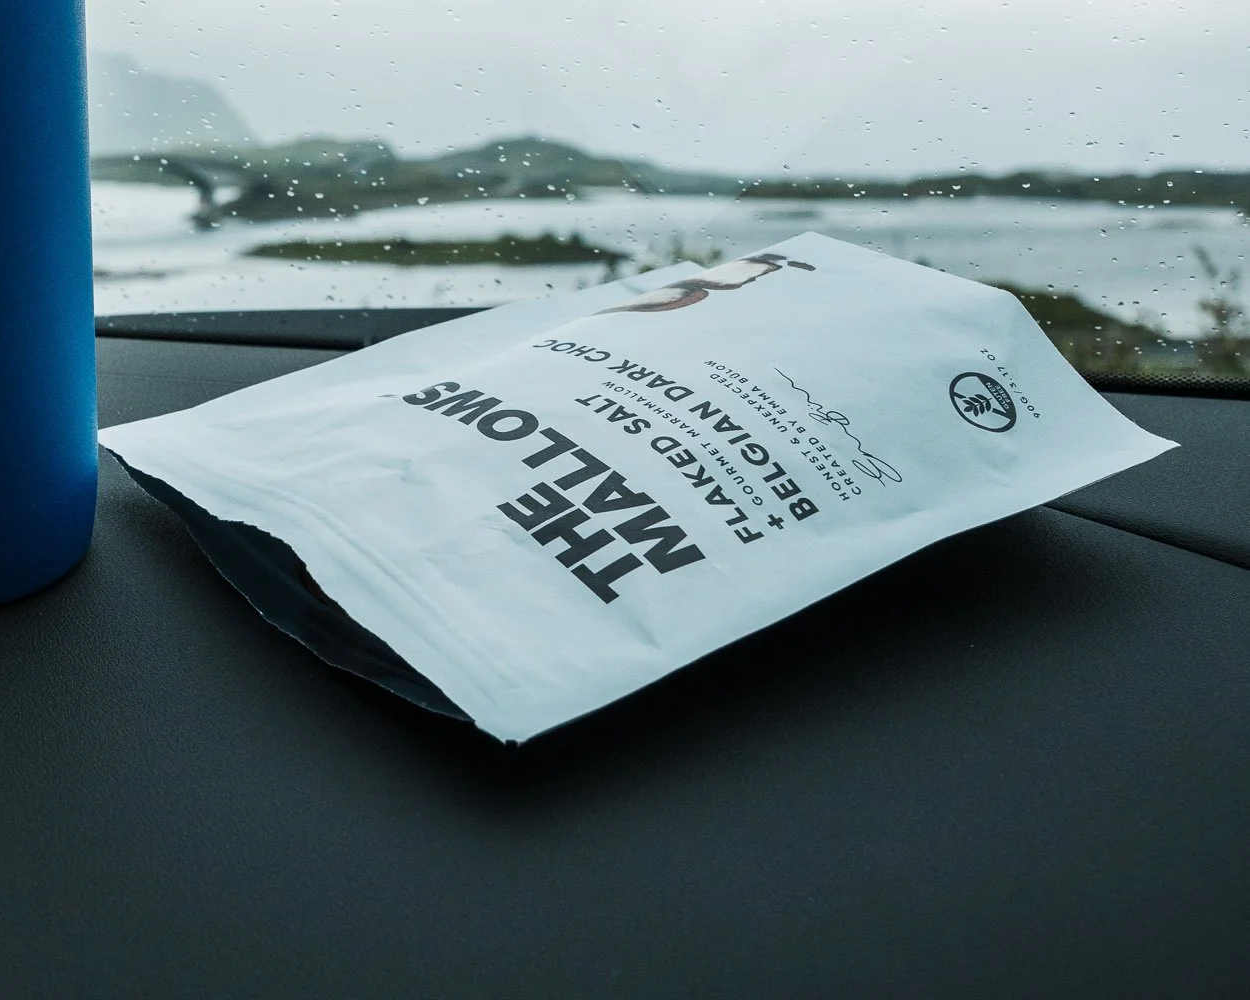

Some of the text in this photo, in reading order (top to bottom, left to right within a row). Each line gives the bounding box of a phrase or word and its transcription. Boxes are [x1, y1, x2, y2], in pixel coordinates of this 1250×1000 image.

[602, 381, 700, 438] MARSHMALLOW
[710, 373, 788, 433] UNEXPECTED
[980, 348, 1041, 418] 90G/3.17 OZ
[985, 382, 1010, 410] GLUTEN
[994, 384, 1012, 404] FREE
[532, 339, 820, 521] BELGIAN DARK CHOC
[704, 360, 862, 496] CREATED BY EMMA BÜLOW
[790, 437, 800, 445] &
[403, 382, 706, 575] MALLOWS
[574, 394, 764, 544] FLAKED SALT
[701, 442, 763, 506] GOURMET
[801, 450, 850, 501] HONEST
[496, 482, 644, 604] THE
